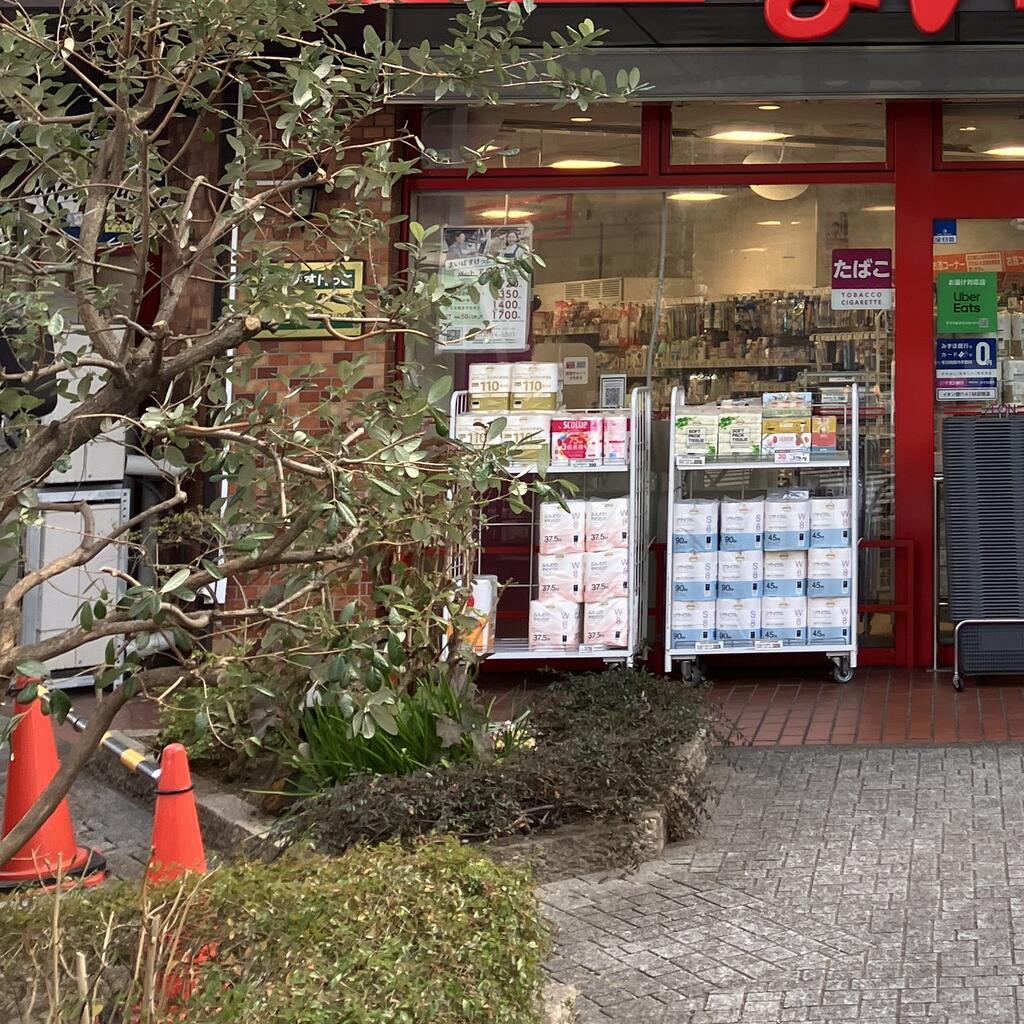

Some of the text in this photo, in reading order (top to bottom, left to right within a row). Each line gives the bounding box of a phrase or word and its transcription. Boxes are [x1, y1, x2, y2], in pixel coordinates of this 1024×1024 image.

[833, 258, 890, 279] たばこ
[495, 289, 519, 299] 350
[953, 291, 981, 302] Uber
[953, 303, 981, 313] Eats
[480, 381, 499, 391] 110
[523, 381, 542, 391] 110
